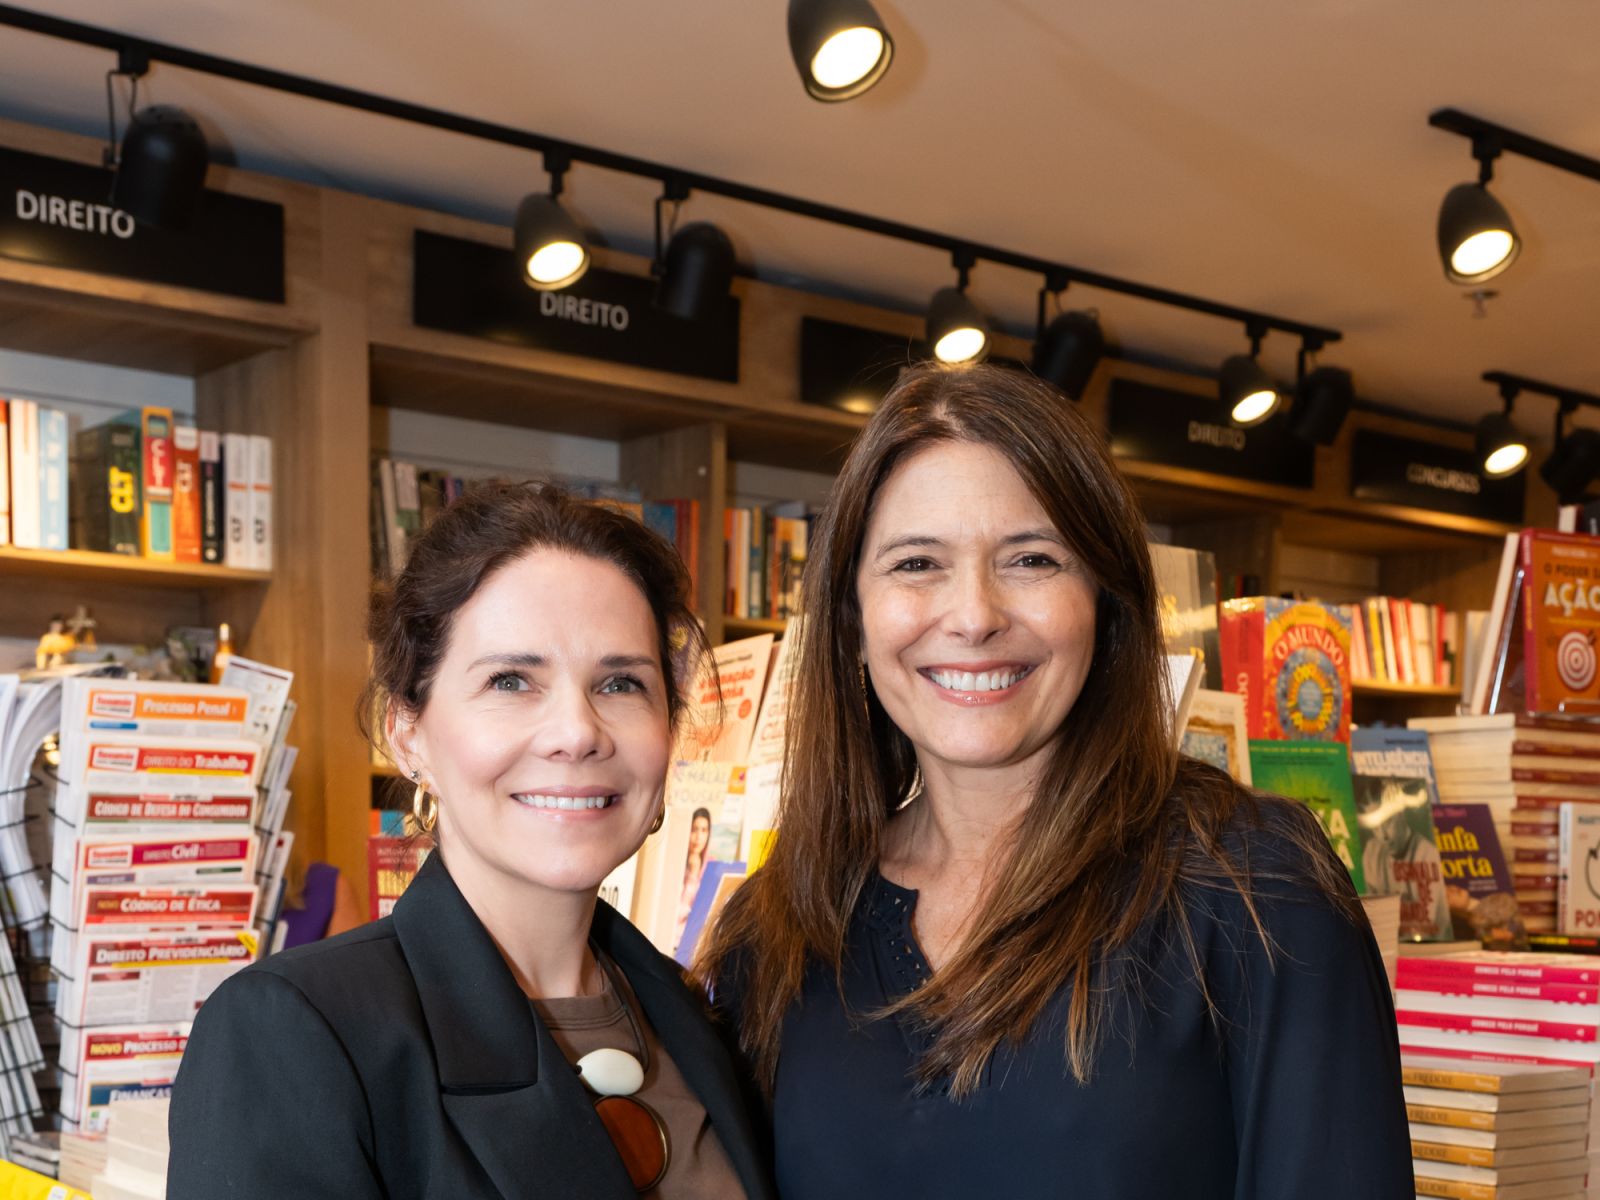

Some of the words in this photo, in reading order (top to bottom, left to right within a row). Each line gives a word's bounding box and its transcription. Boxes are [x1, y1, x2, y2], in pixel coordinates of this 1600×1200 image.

[16, 189, 135, 239] DIREITO
[540, 291, 630, 331] DIREITO
[1188, 420, 1246, 451] DIREITO
[150, 439, 166, 488] CLT
[1406, 462, 1481, 494] CONCURSOS
[108, 466, 134, 513] CLT
[1544, 577, 1600, 617] AÇÃO
[1274, 640, 1289, 660] O
[1287, 624, 1344, 665] MUNDO
[143, 699, 196, 715] Processo
[197, 701, 231, 716] Penal
[195, 754, 248, 770] Trabalho
[171, 843, 200, 859] Civil
[1436, 825, 1480, 852] infa
[1440, 854, 1494, 877] orta
[120, 898, 168, 912] CÓDIGO
[169, 899, 185, 912] DE
[188, 897, 221, 911] ÉTICA
[96, 948, 147, 963] DIREITO
[148, 944, 247, 961] PREVIDENCIÁRIO
[123, 1040, 178, 1054] PROCESSO
